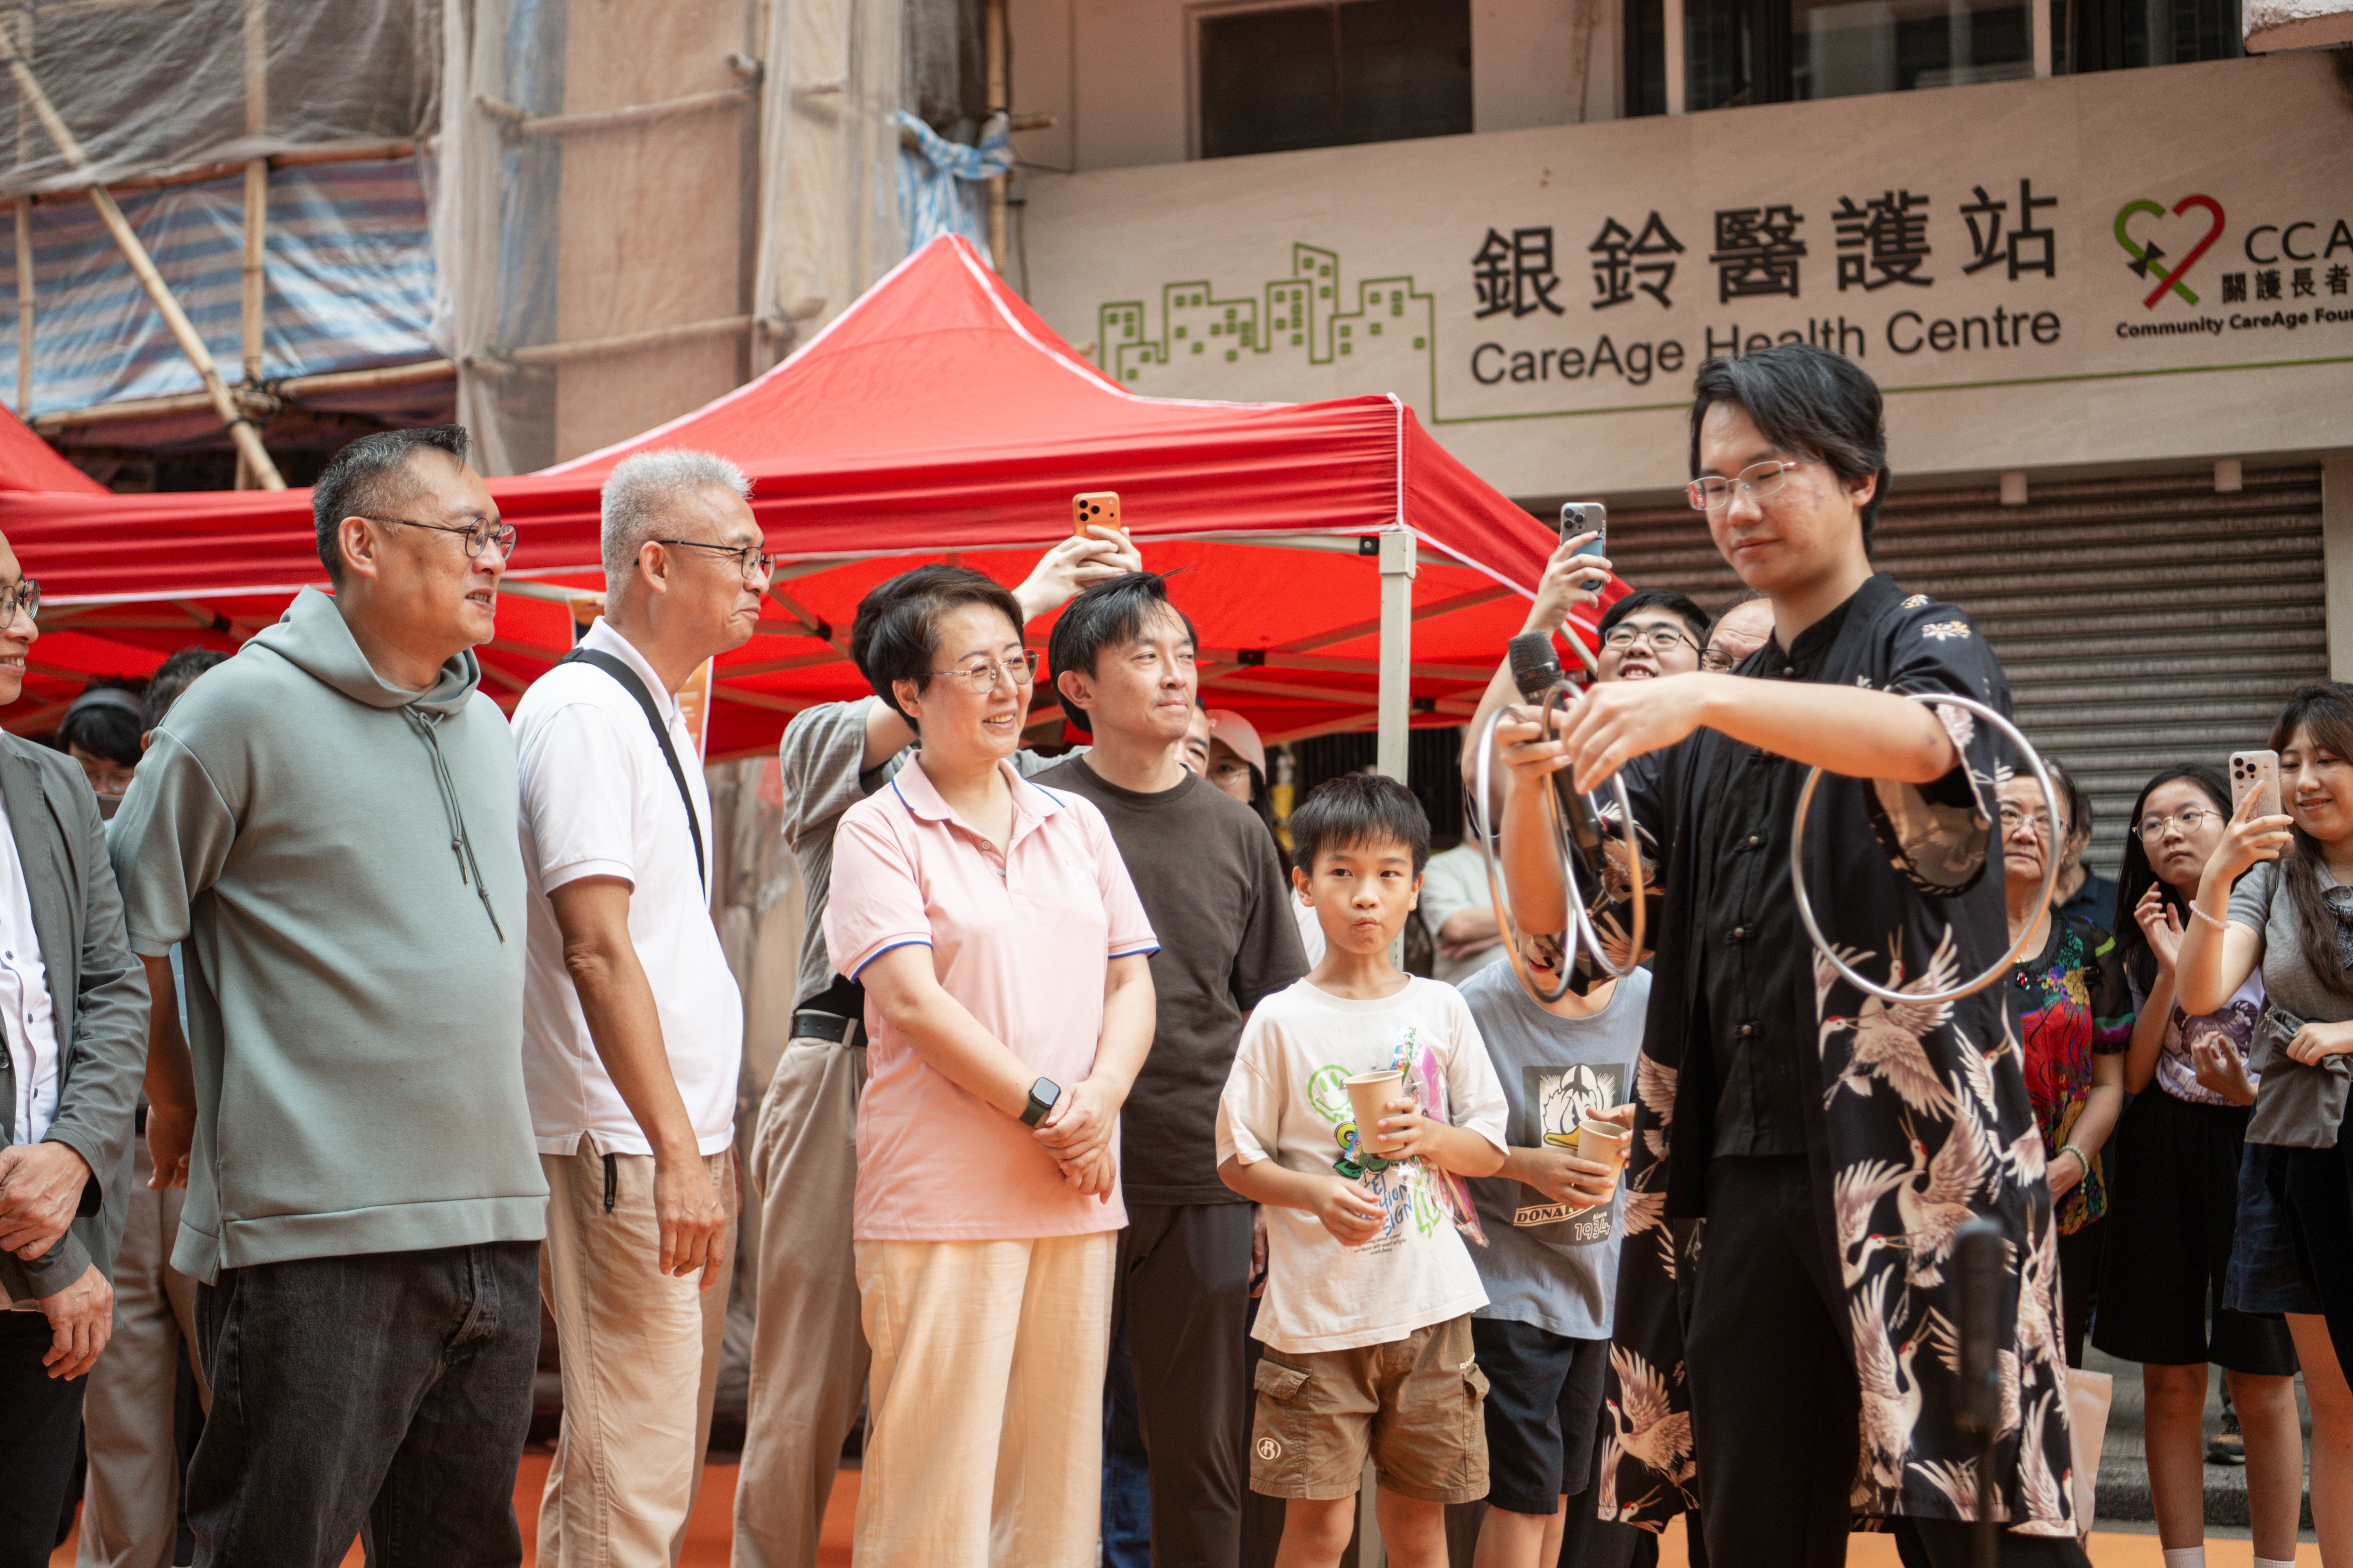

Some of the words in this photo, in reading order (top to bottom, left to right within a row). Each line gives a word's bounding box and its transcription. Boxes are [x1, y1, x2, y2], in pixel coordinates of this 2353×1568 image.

[1471, 177, 2058, 318] 銀鈴醫護站
[2117, 315, 2224, 338] Community
[2230, 310, 2309, 331] CareAge
[2315, 307, 2353, 323] Fou
[1471, 334, 1684, 384] CareAge
[1886, 304, 2061, 354] Centre
[1517, 1206, 1577, 1222] DONAL
[1592, 1211, 1607, 1221] Since
[1575, 1218, 1611, 1241] 1934
